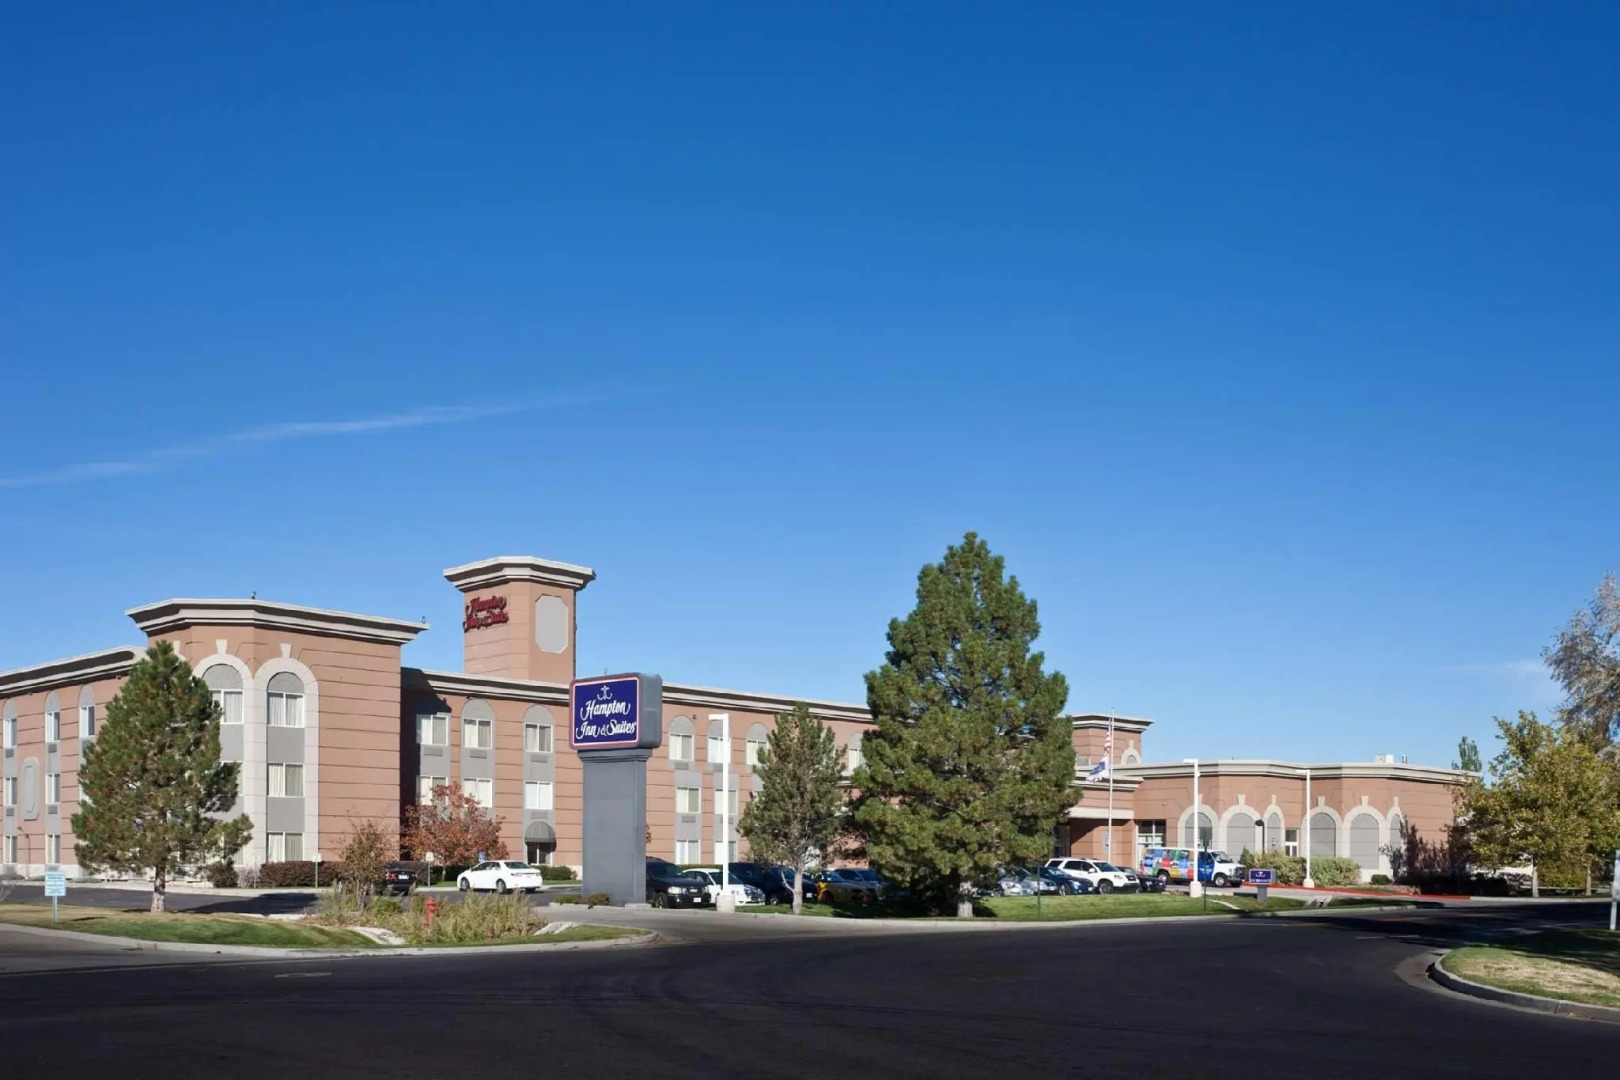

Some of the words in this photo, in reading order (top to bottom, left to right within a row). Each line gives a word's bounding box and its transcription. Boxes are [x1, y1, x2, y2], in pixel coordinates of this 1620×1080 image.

[580, 699, 631, 721] Hampton
[576, 721, 600, 739] Inn
[600, 724, 608, 736] &
[606, 719, 637, 736] Suites
